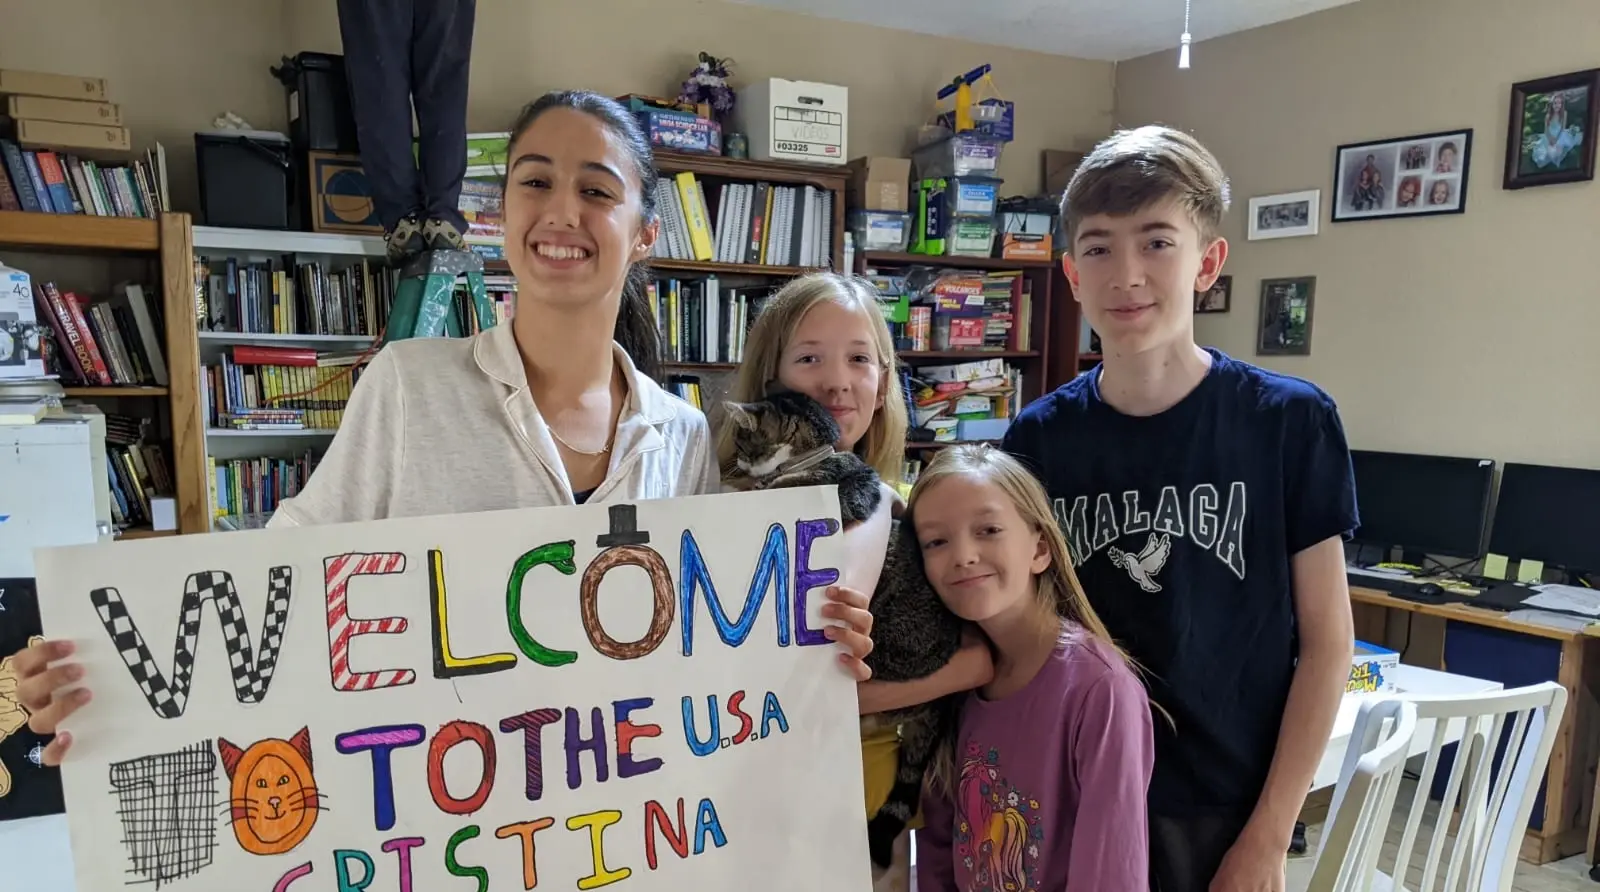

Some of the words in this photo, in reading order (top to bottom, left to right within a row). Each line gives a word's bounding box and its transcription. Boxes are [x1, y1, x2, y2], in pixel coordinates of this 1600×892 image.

[777, 142, 809, 152] #03325
[792, 126, 829, 141] VIDEOS
[57, 307, 81, 345] TRAVEL
[75, 344, 94, 373] BOOK
[1053, 481, 1246, 580] MALAGA
[90, 515, 840, 719] WELCOME
